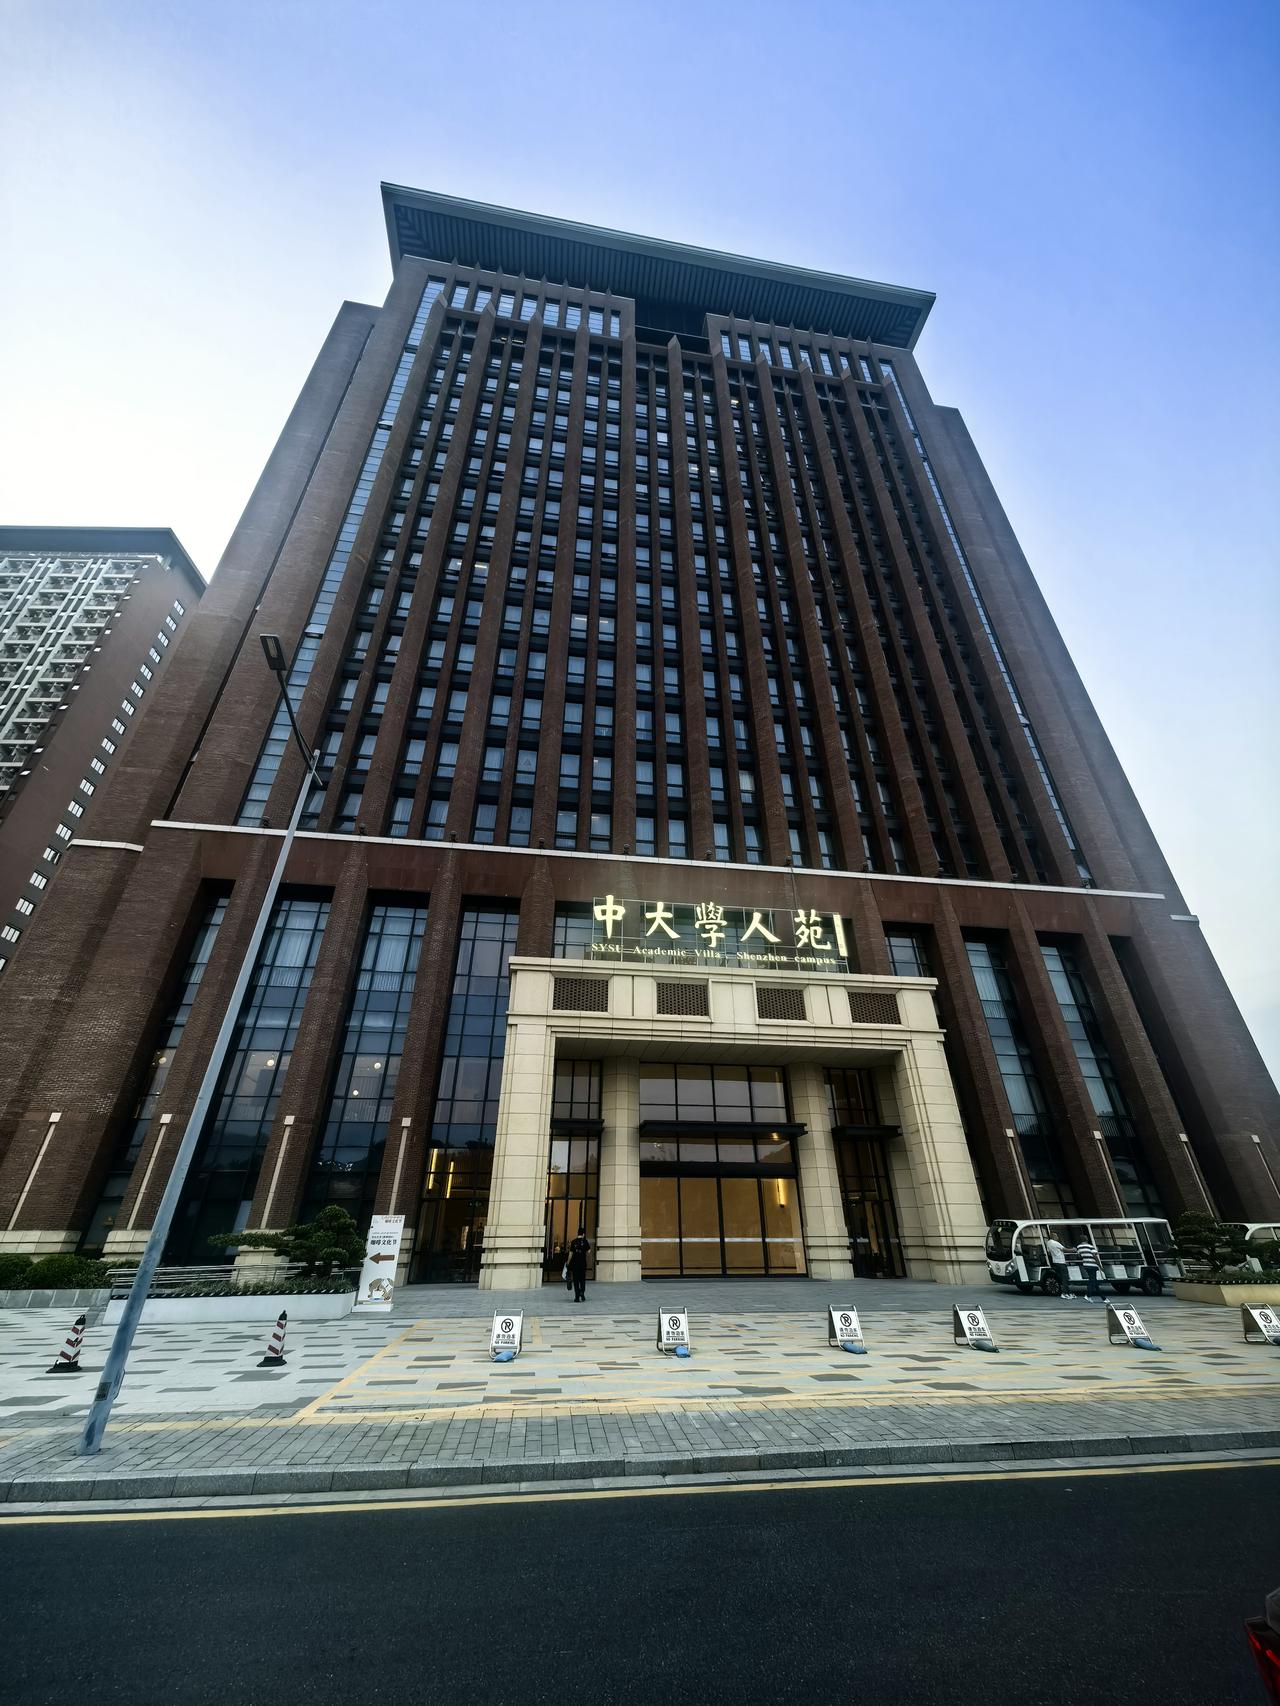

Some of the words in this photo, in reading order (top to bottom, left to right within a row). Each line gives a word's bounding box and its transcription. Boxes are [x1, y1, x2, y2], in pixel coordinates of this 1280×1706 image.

[593, 894, 832, 949] 中大學人苑
[591, 943, 624, 953] SYSU
[633, 946, 687, 957] Academic
[736, 952, 787, 962] Shenzhen
[794, 956, 836, 966] campus
